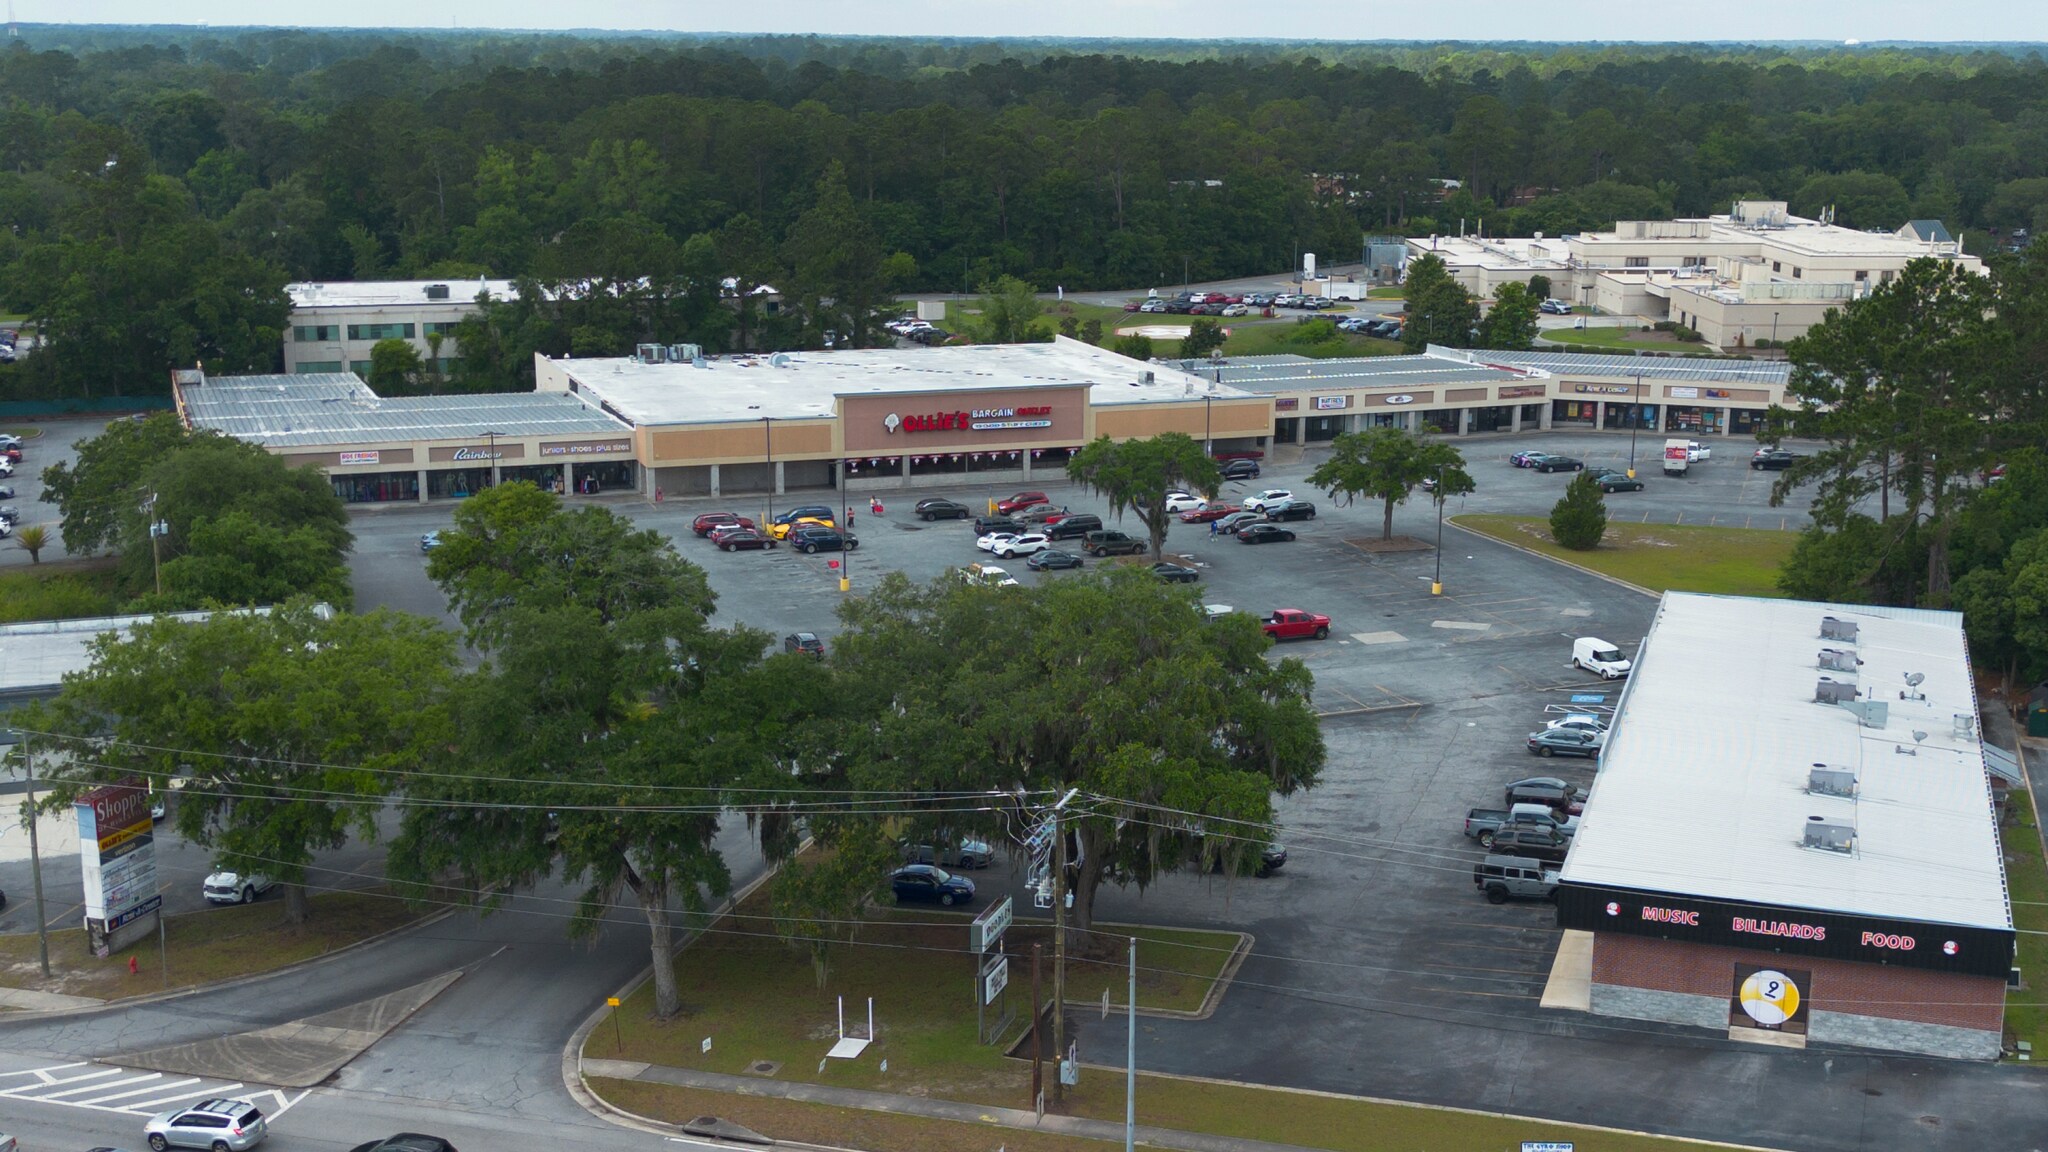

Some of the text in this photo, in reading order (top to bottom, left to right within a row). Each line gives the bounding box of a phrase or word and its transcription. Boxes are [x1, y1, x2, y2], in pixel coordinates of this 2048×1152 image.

[972, 408, 1014, 418] BARGAIN
[453, 447, 502, 460] Rainbow
[1642, 906, 1699, 926] MUSIC
[1732, 917, 1826, 941] BILLIARDS
[1861, 931, 1916, 951] FOOD
